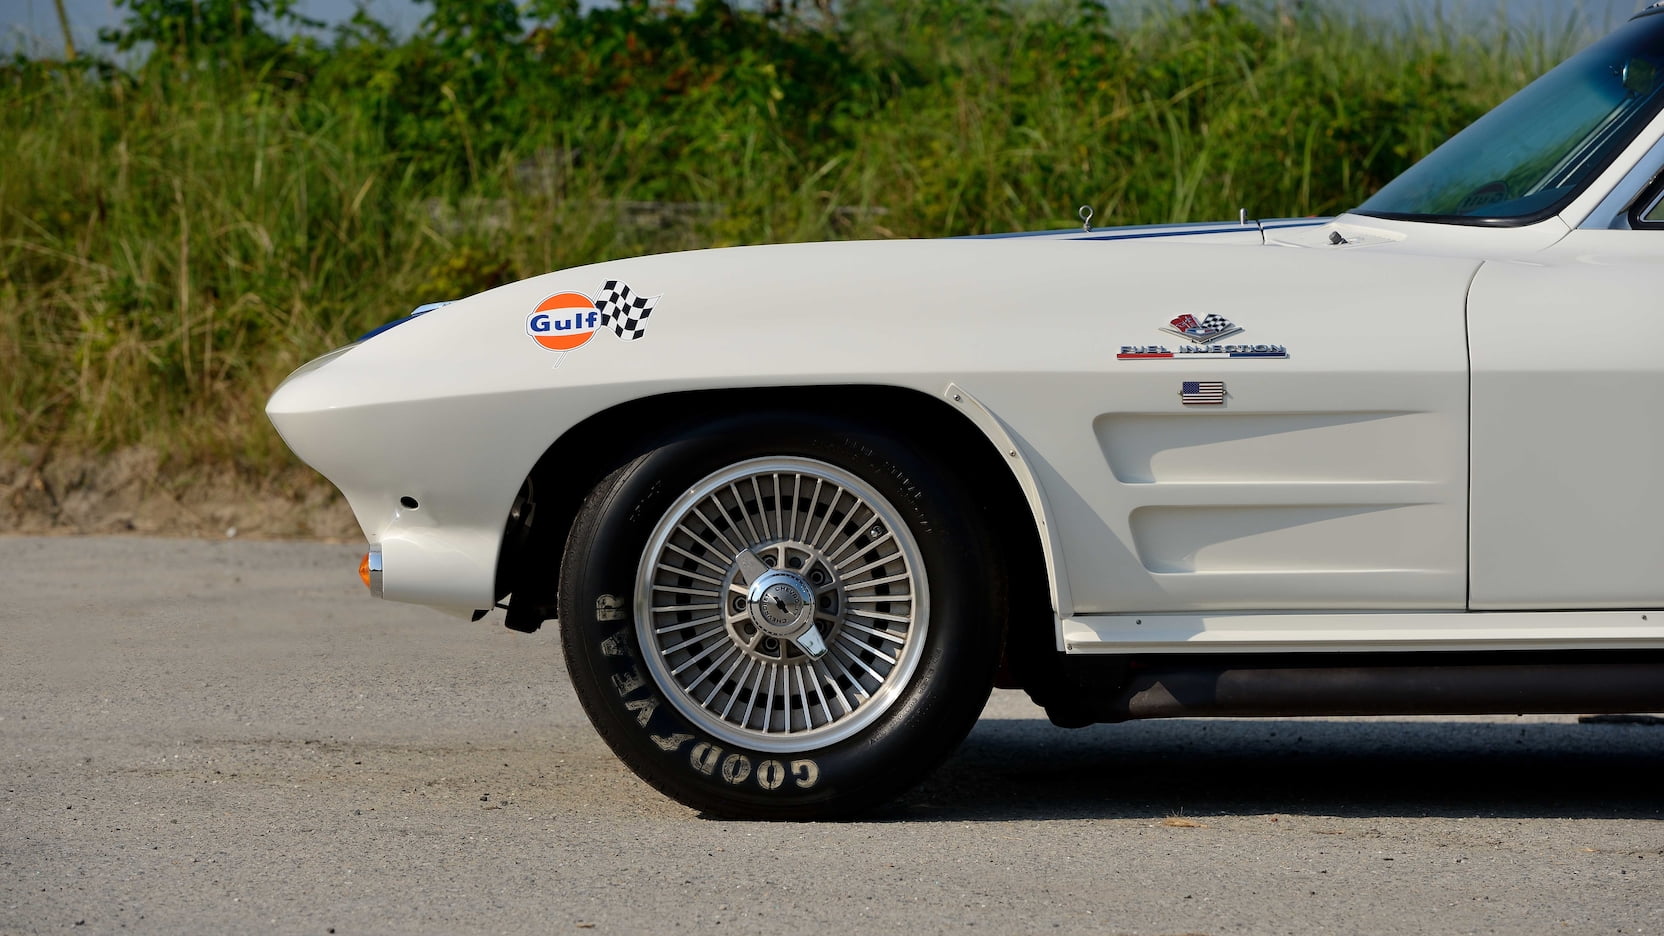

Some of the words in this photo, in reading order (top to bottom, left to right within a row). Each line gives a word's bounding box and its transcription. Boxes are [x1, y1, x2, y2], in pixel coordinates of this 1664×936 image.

[530, 312, 598, 332] Gulf
[1121, 345, 1171, 354] FUEL
[1180, 345, 1286, 354] INJECTION
[775, 587, 800, 617] CHEVROET
